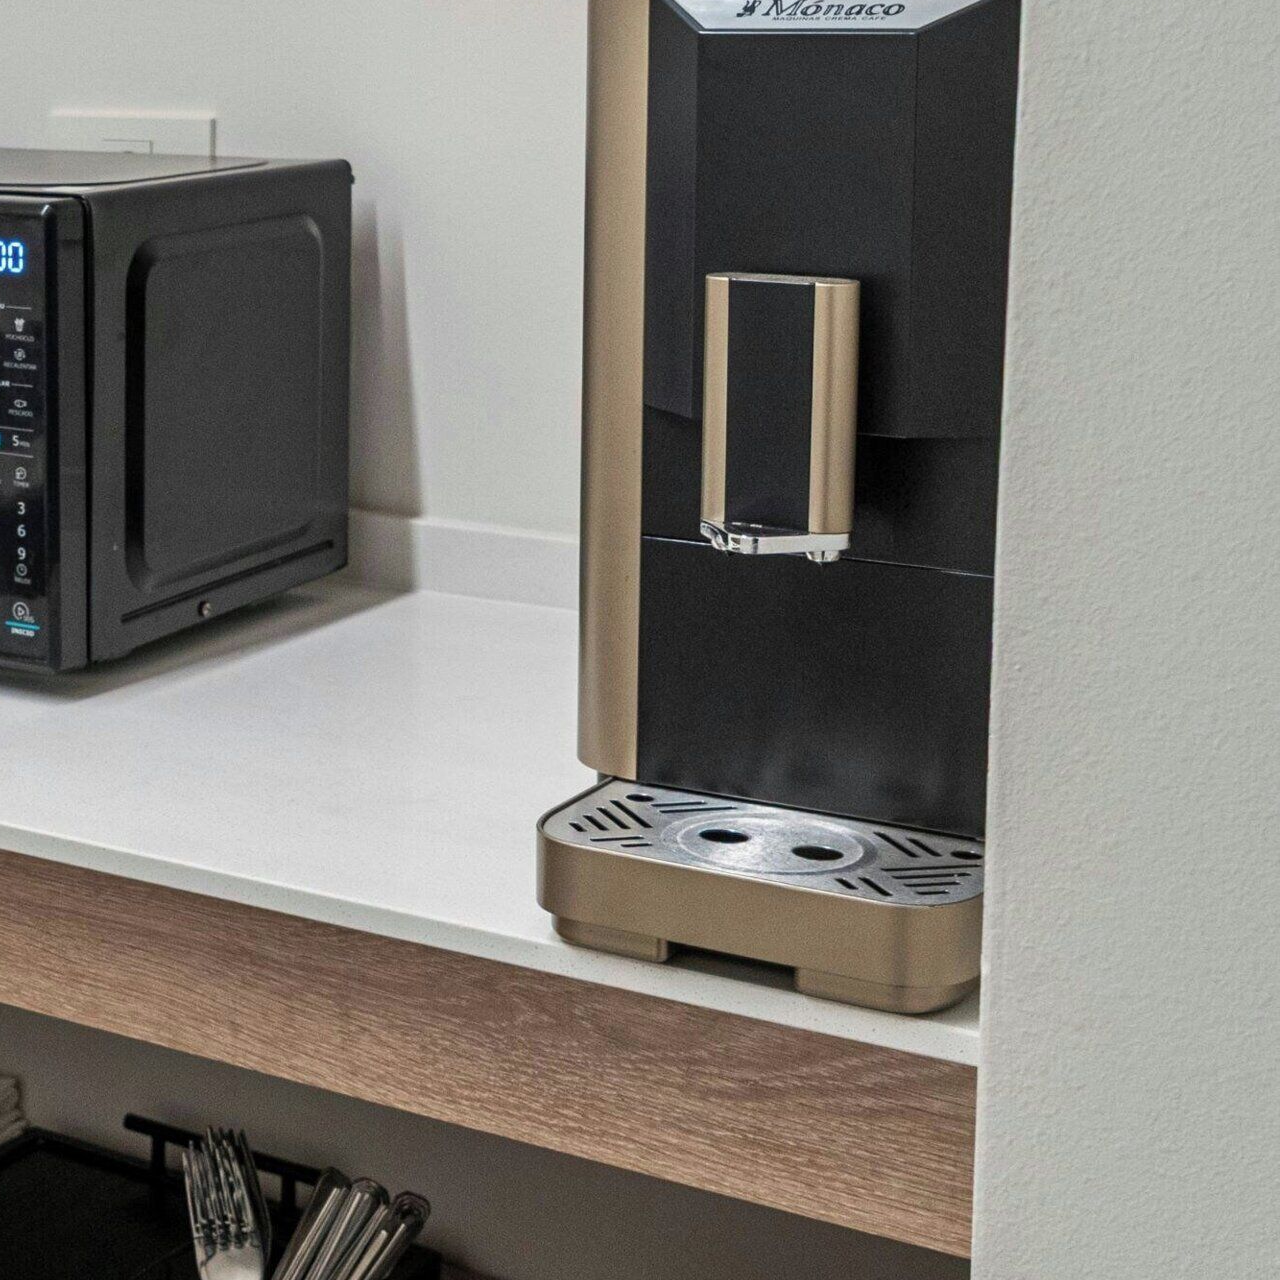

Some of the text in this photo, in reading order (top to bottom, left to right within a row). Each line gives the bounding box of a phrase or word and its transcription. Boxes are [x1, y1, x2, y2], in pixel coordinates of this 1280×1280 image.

[17, 501, 26, 515] 3
[16, 524, 27, 537] 6
[17, 547, 26, 560] 9
